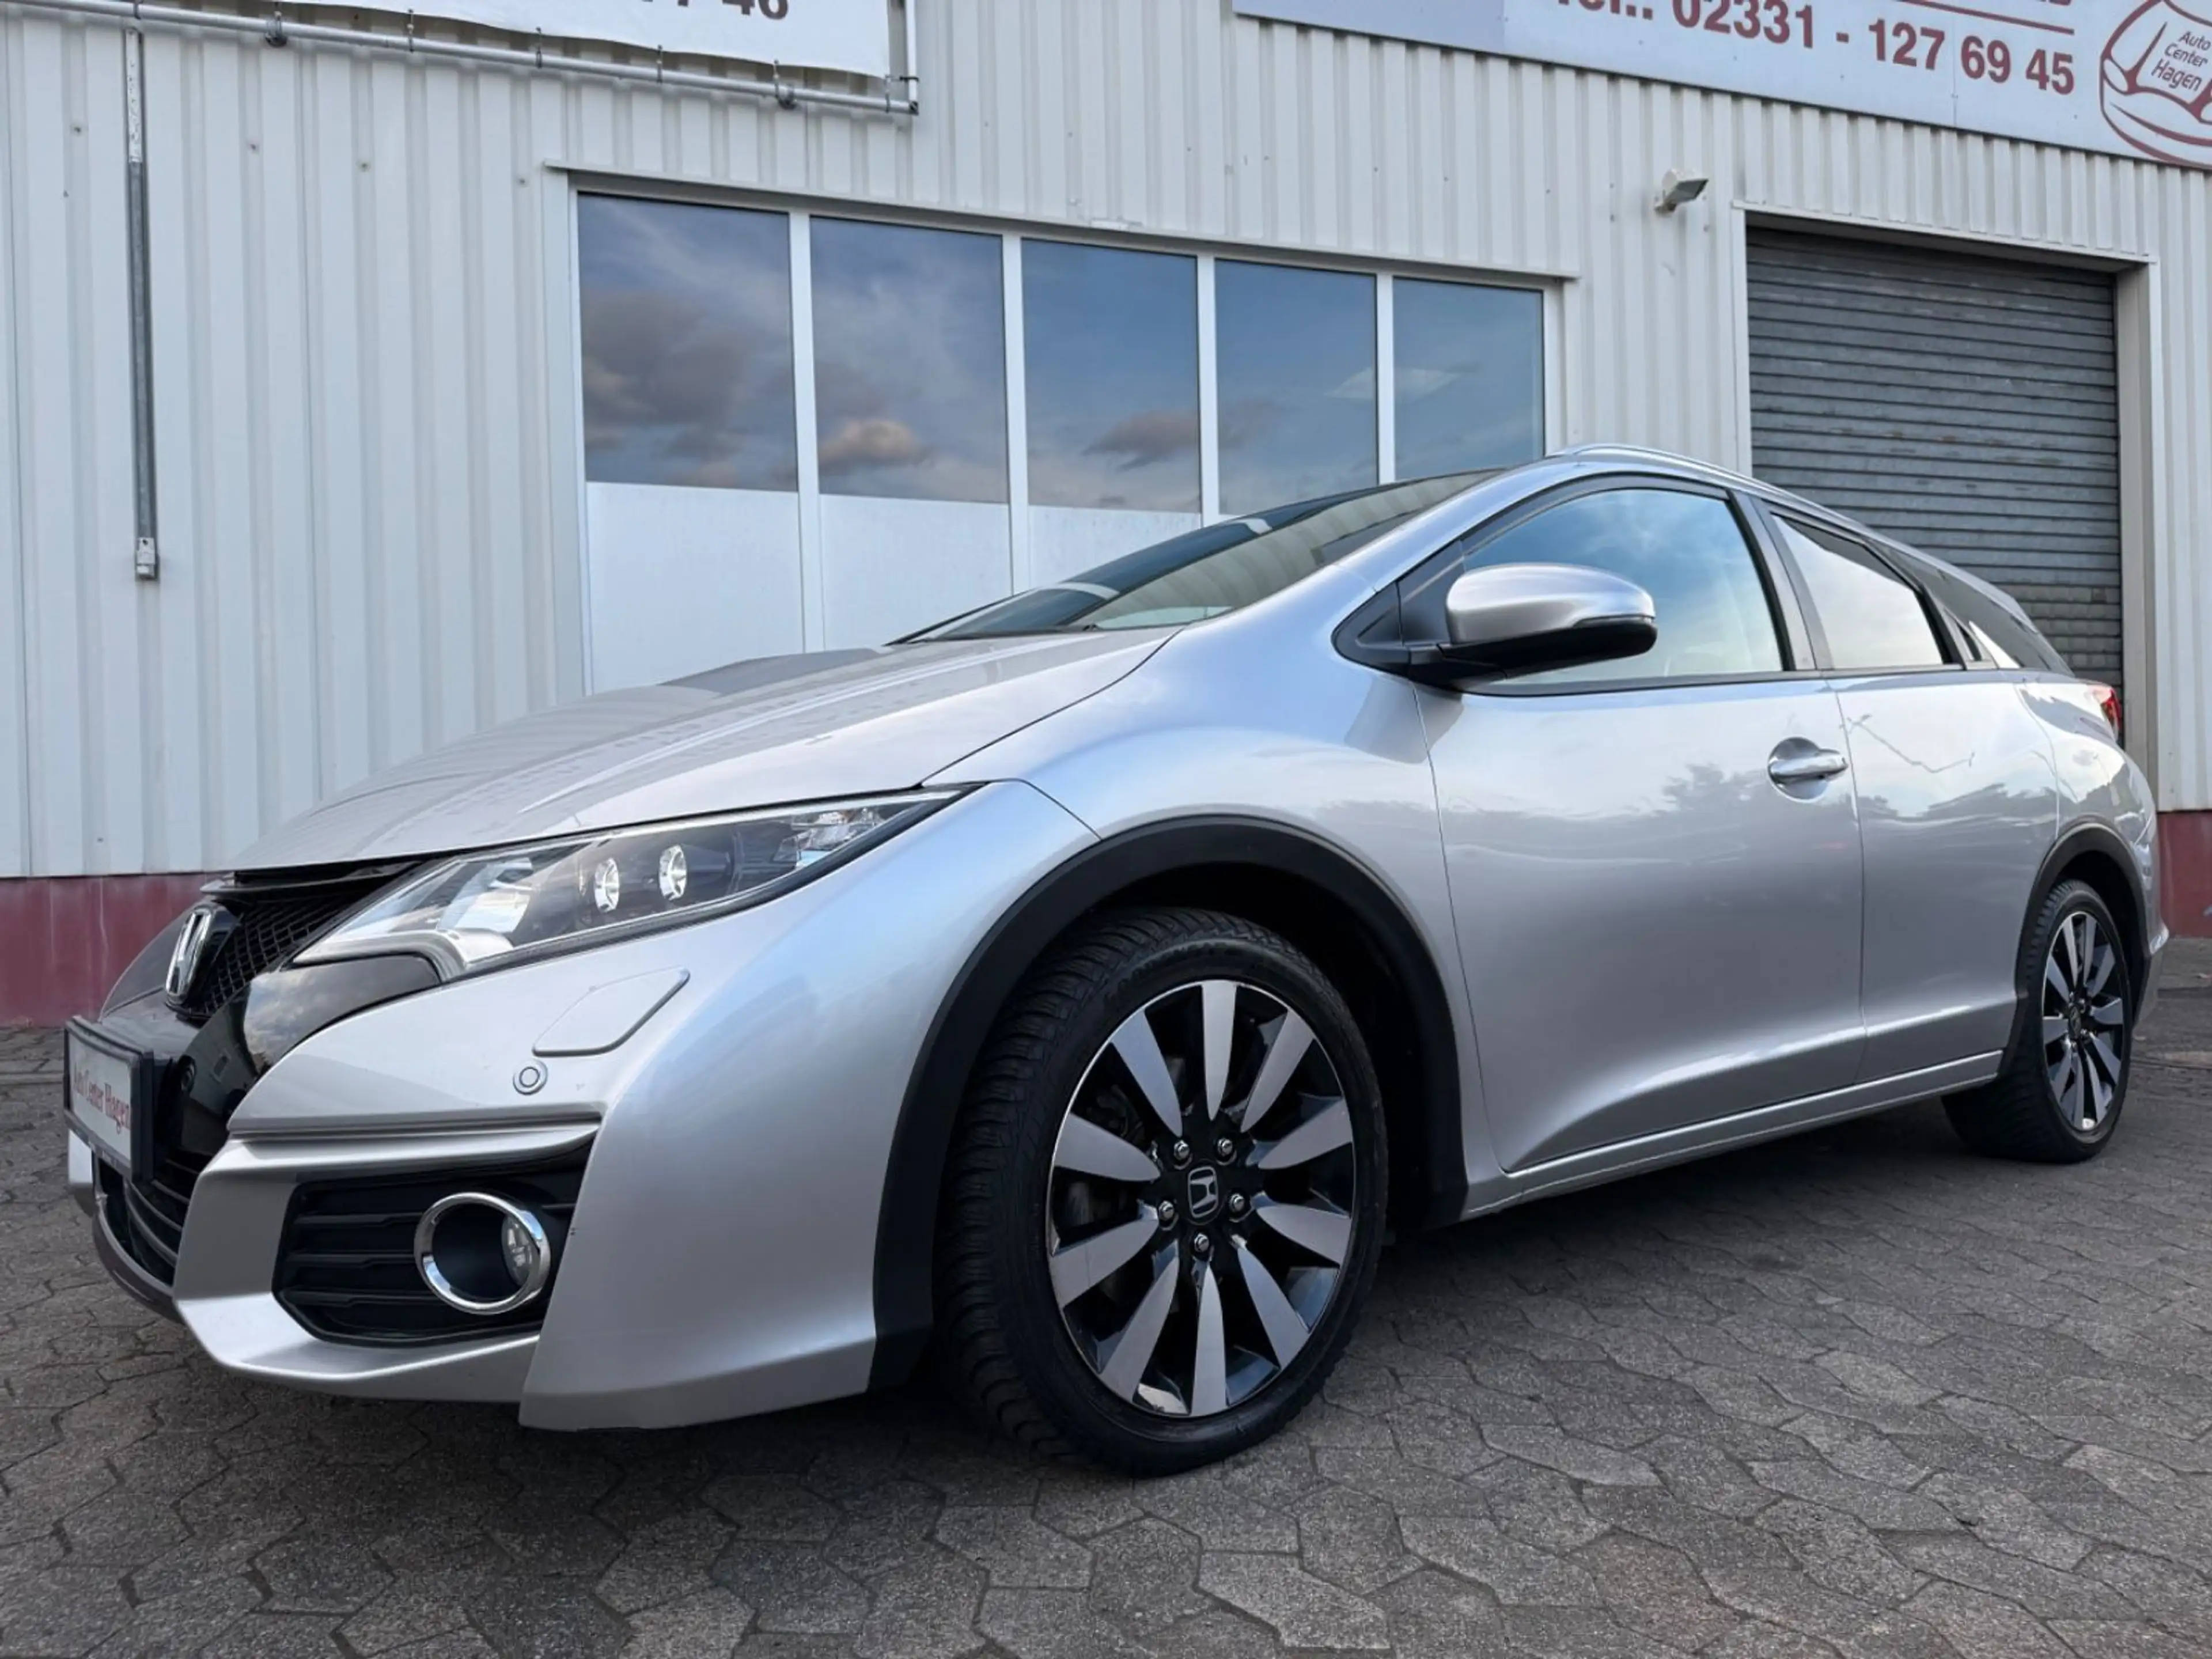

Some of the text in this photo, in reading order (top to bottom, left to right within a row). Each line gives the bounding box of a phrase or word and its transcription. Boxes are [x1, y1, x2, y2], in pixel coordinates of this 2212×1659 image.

[1672, 0, 1813, 48] 02331
[1836, 32, 1849, 43] -
[1869, 18, 1945, 70] 127
[1961, 35, 2011, 83] 69
[2025, 48, 2074, 94] 45
[2164, 42, 2208, 67] Center
[2179, 31, 2211, 51] Auto
[2151, 58, 2202, 92] Hagen
